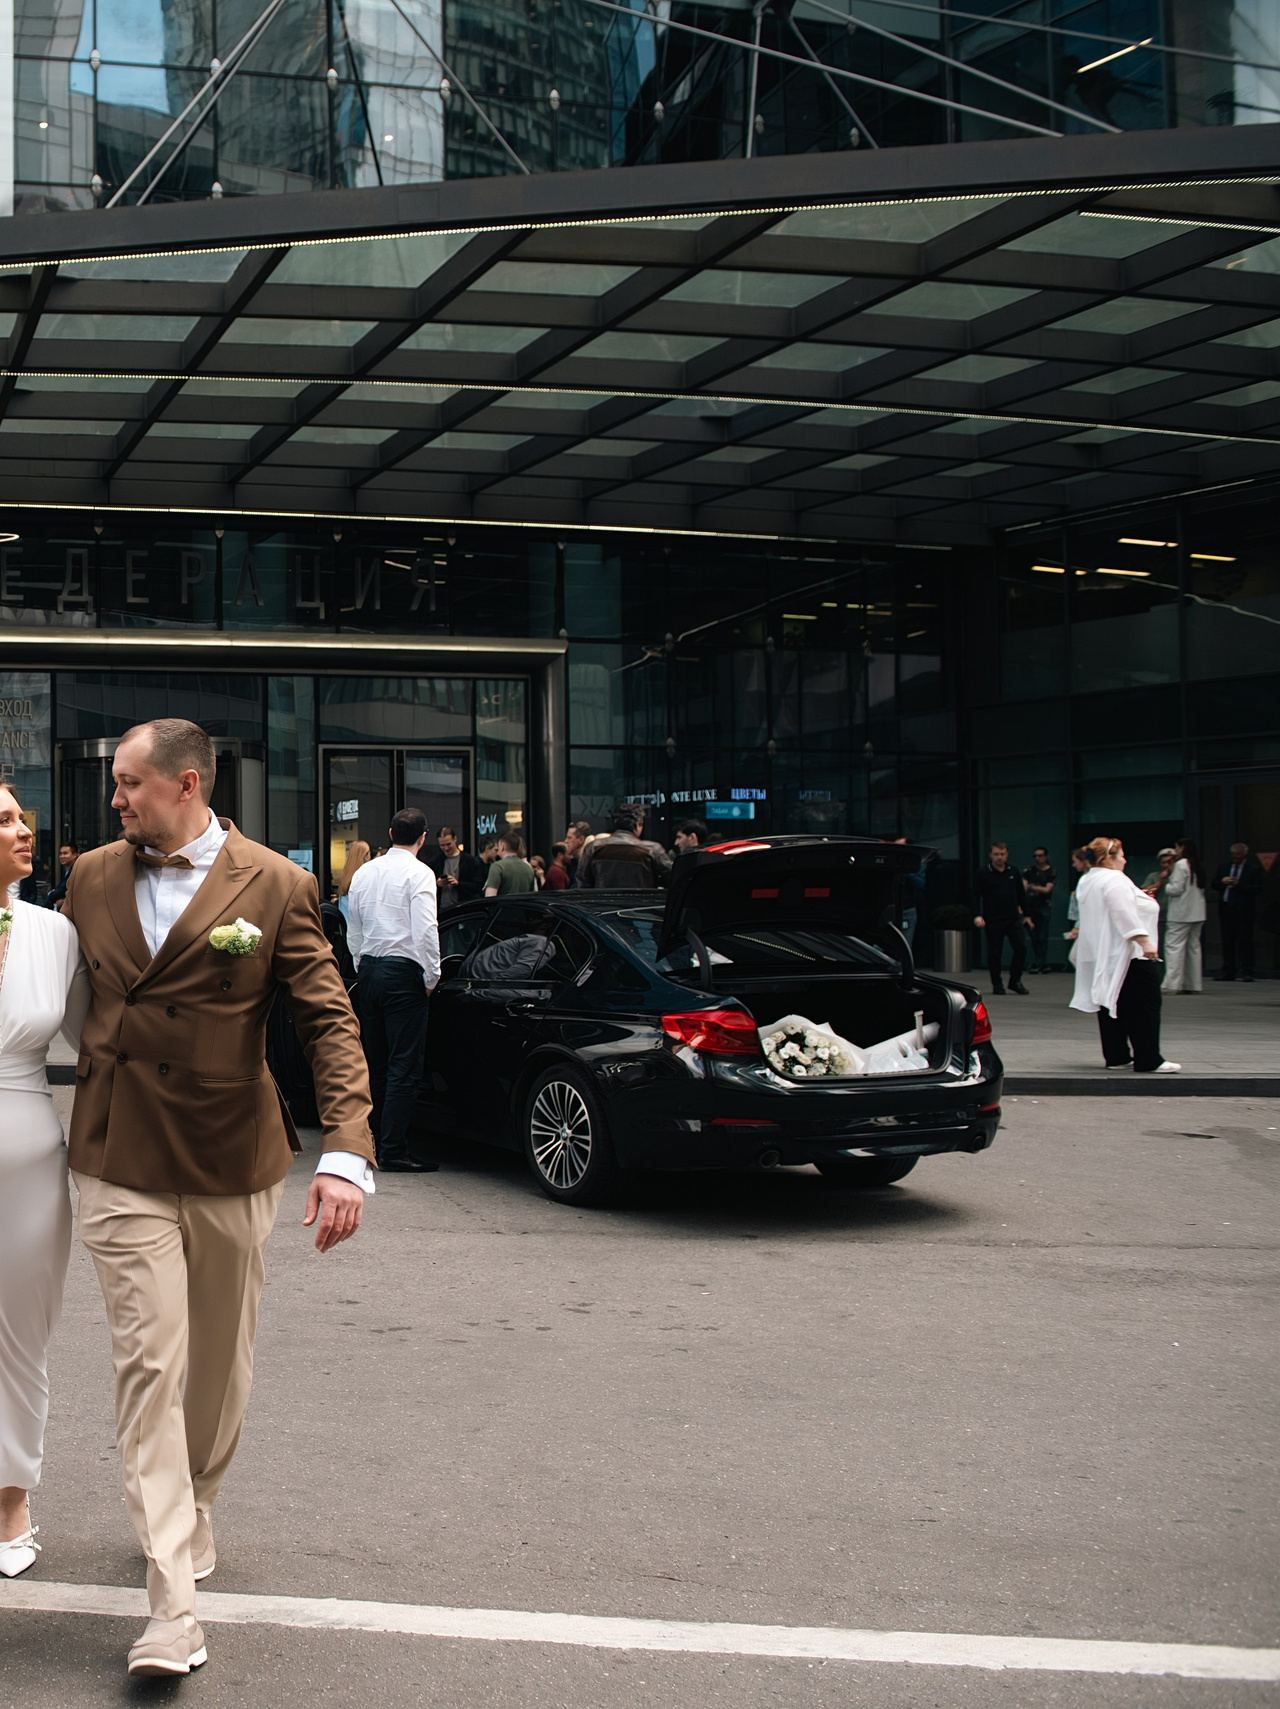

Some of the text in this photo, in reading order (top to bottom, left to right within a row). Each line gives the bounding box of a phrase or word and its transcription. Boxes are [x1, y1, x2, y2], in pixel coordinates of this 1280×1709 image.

[692, 788, 718, 802] LUXE
[730, 787, 767, 801] ЦВЕТЫ
[476, 813, 497, 835] АБАК
